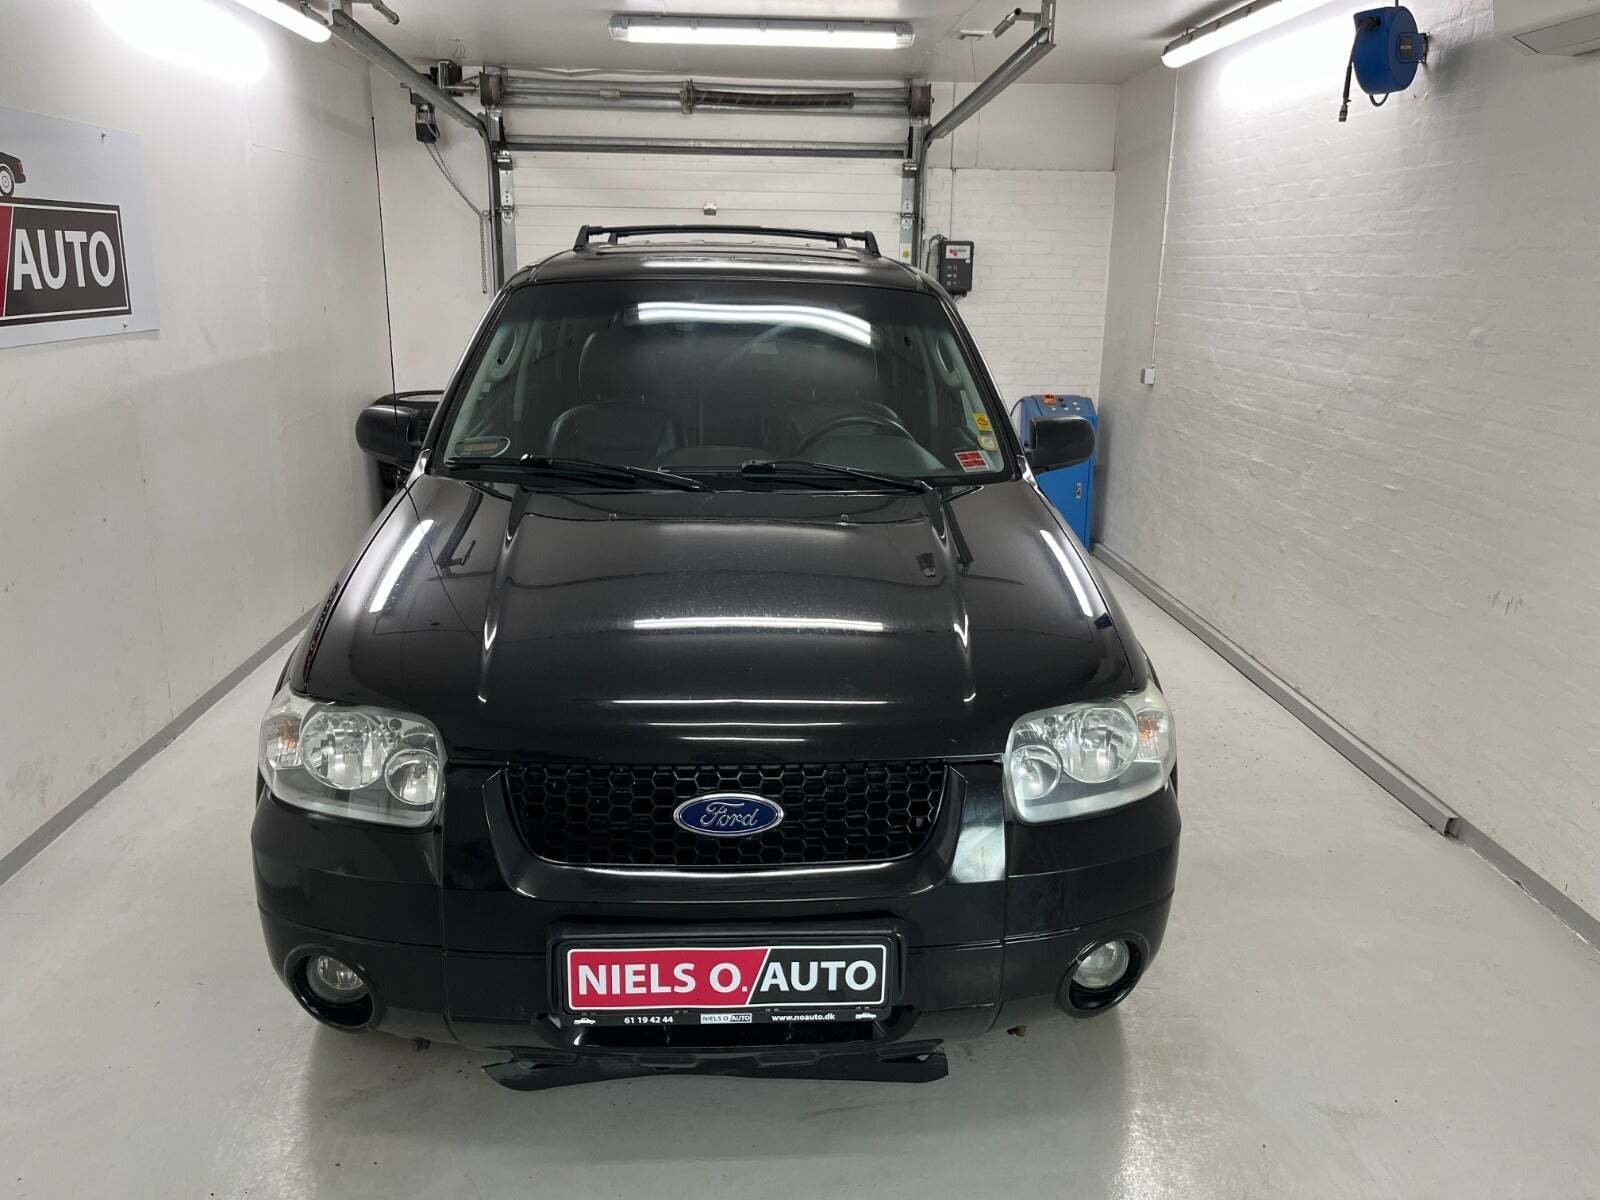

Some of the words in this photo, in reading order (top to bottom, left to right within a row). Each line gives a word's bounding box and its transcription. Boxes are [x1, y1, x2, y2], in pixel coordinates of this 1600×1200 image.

[13, 228, 116, 291] AUTO
[700, 802, 760, 827] Ford
[578, 962, 696, 995] NIELS
[709, 962, 748, 993] O.
[760, 960, 877, 992] AUTO
[624, 1016, 635, 1024] 61
[637, 1016, 648, 1024] 19
[649, 1016, 660, 1024] 42
[771, 1012, 836, 1021] www.noauto.dk
